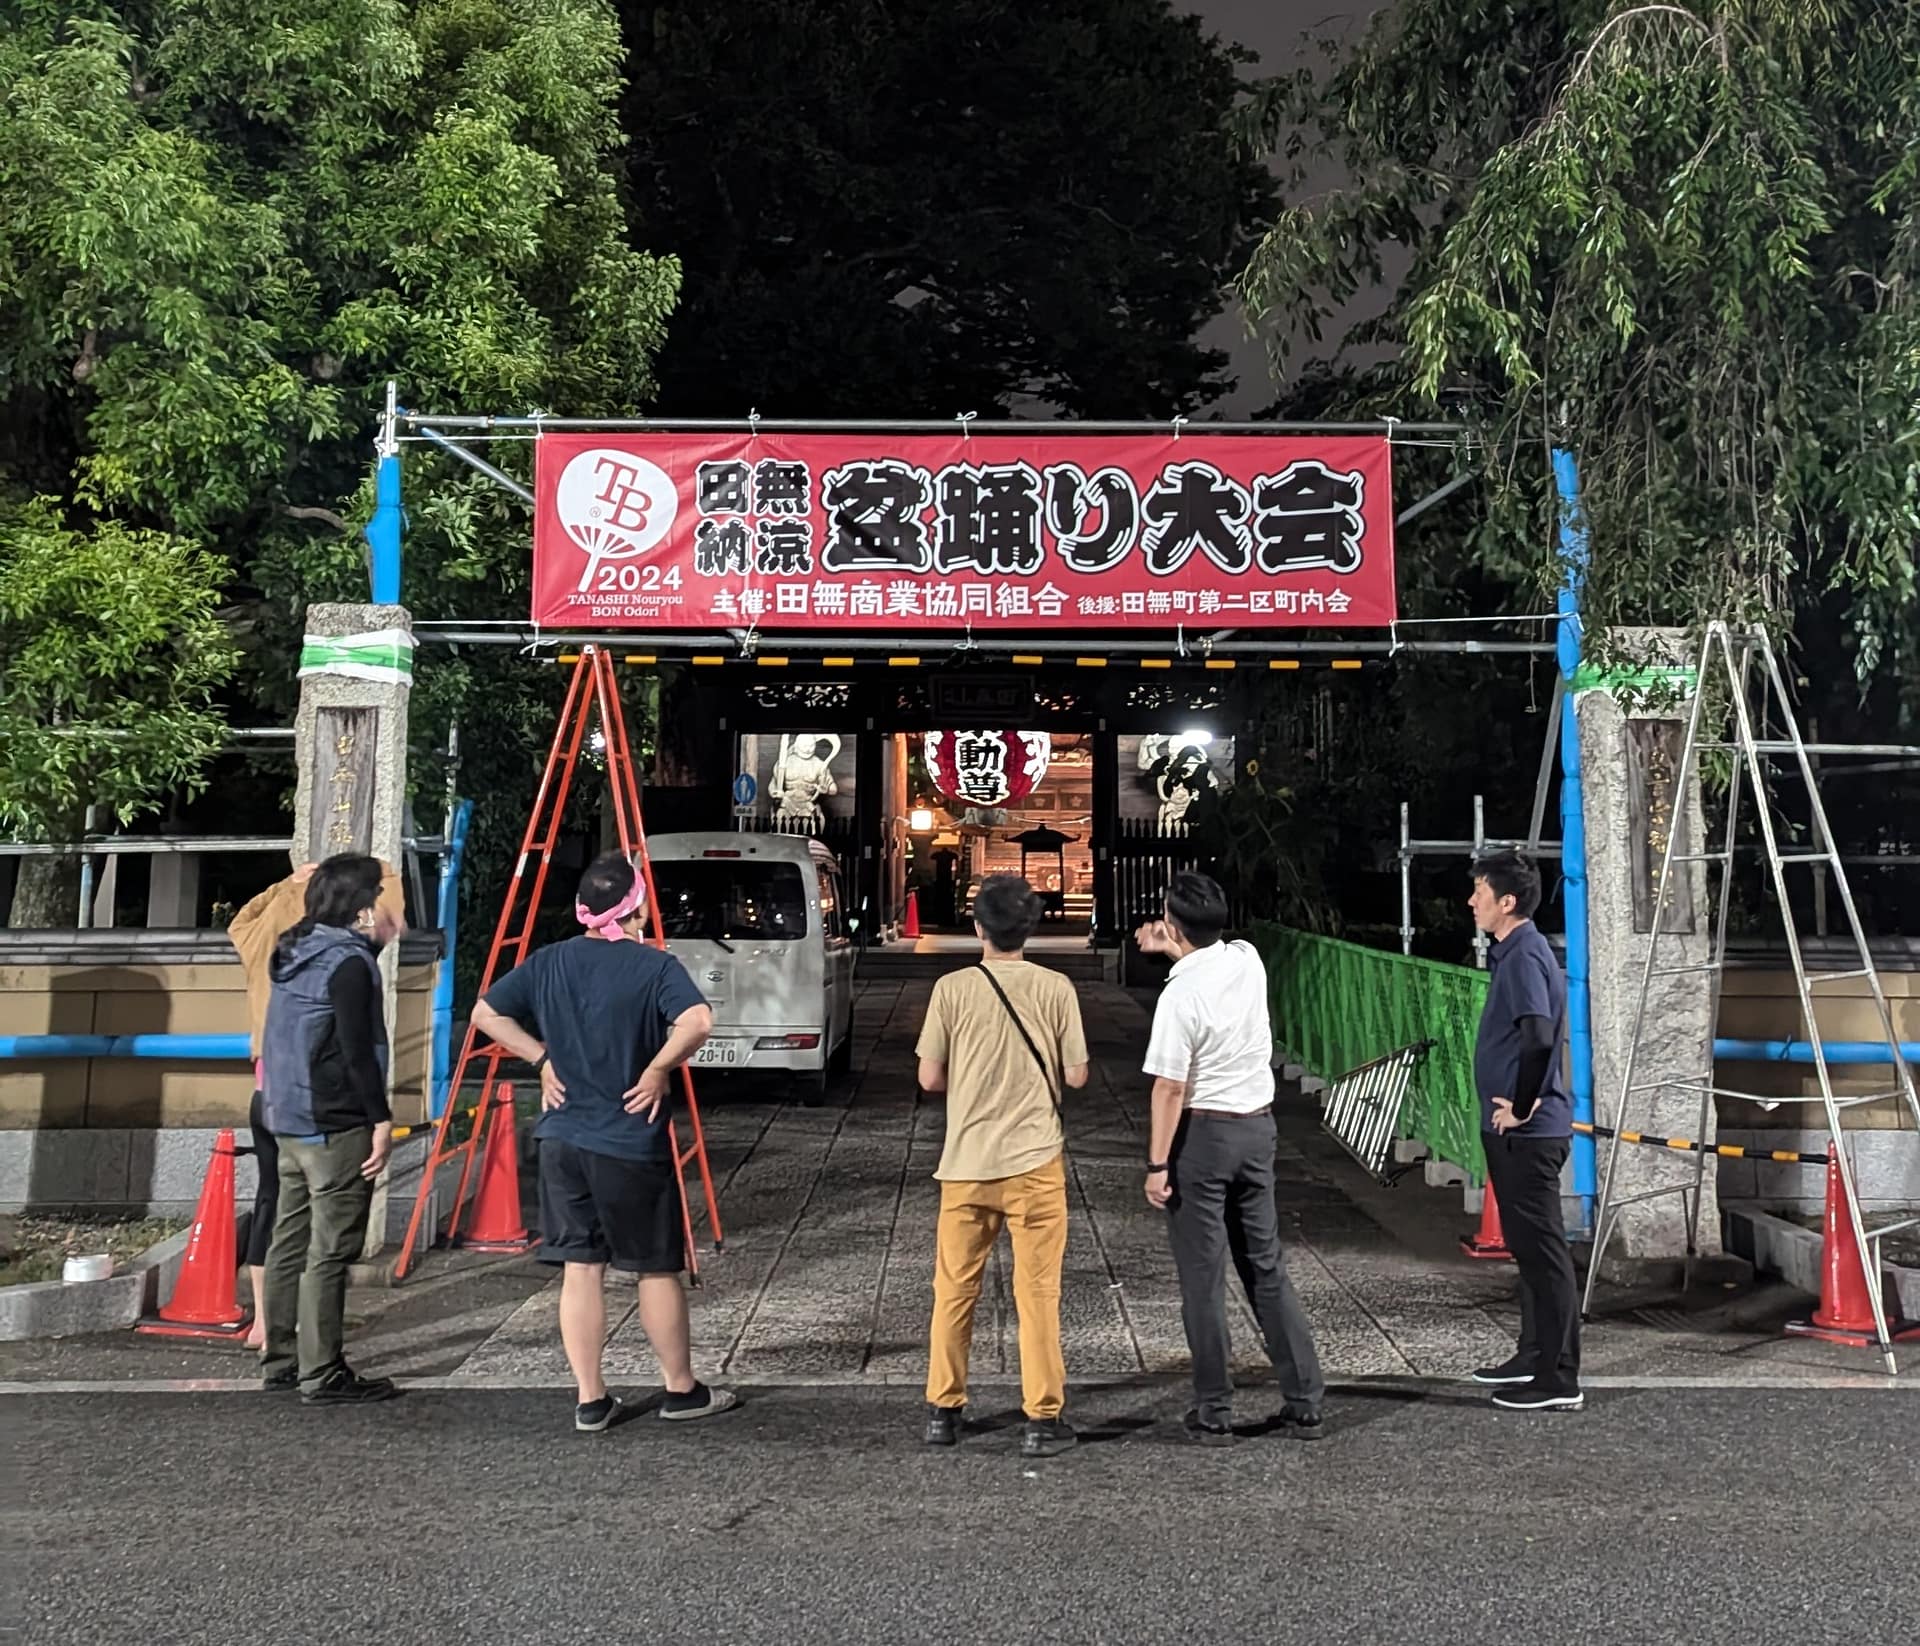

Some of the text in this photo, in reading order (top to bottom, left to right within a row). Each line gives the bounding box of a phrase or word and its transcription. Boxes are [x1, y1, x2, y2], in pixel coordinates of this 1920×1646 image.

[593, 456, 653, 533] TB
[695, 458, 812, 516] 田無
[821, 456, 1366, 576] 盆踊り大会
[694, 517, 814, 577] 納涼
[568, 594, 683, 608] TANASHI Nouryou
[598, 564, 683, 591] 2024
[591, 606, 659, 617] BON Odori
[955, 732, 1006, 802] 動尊
